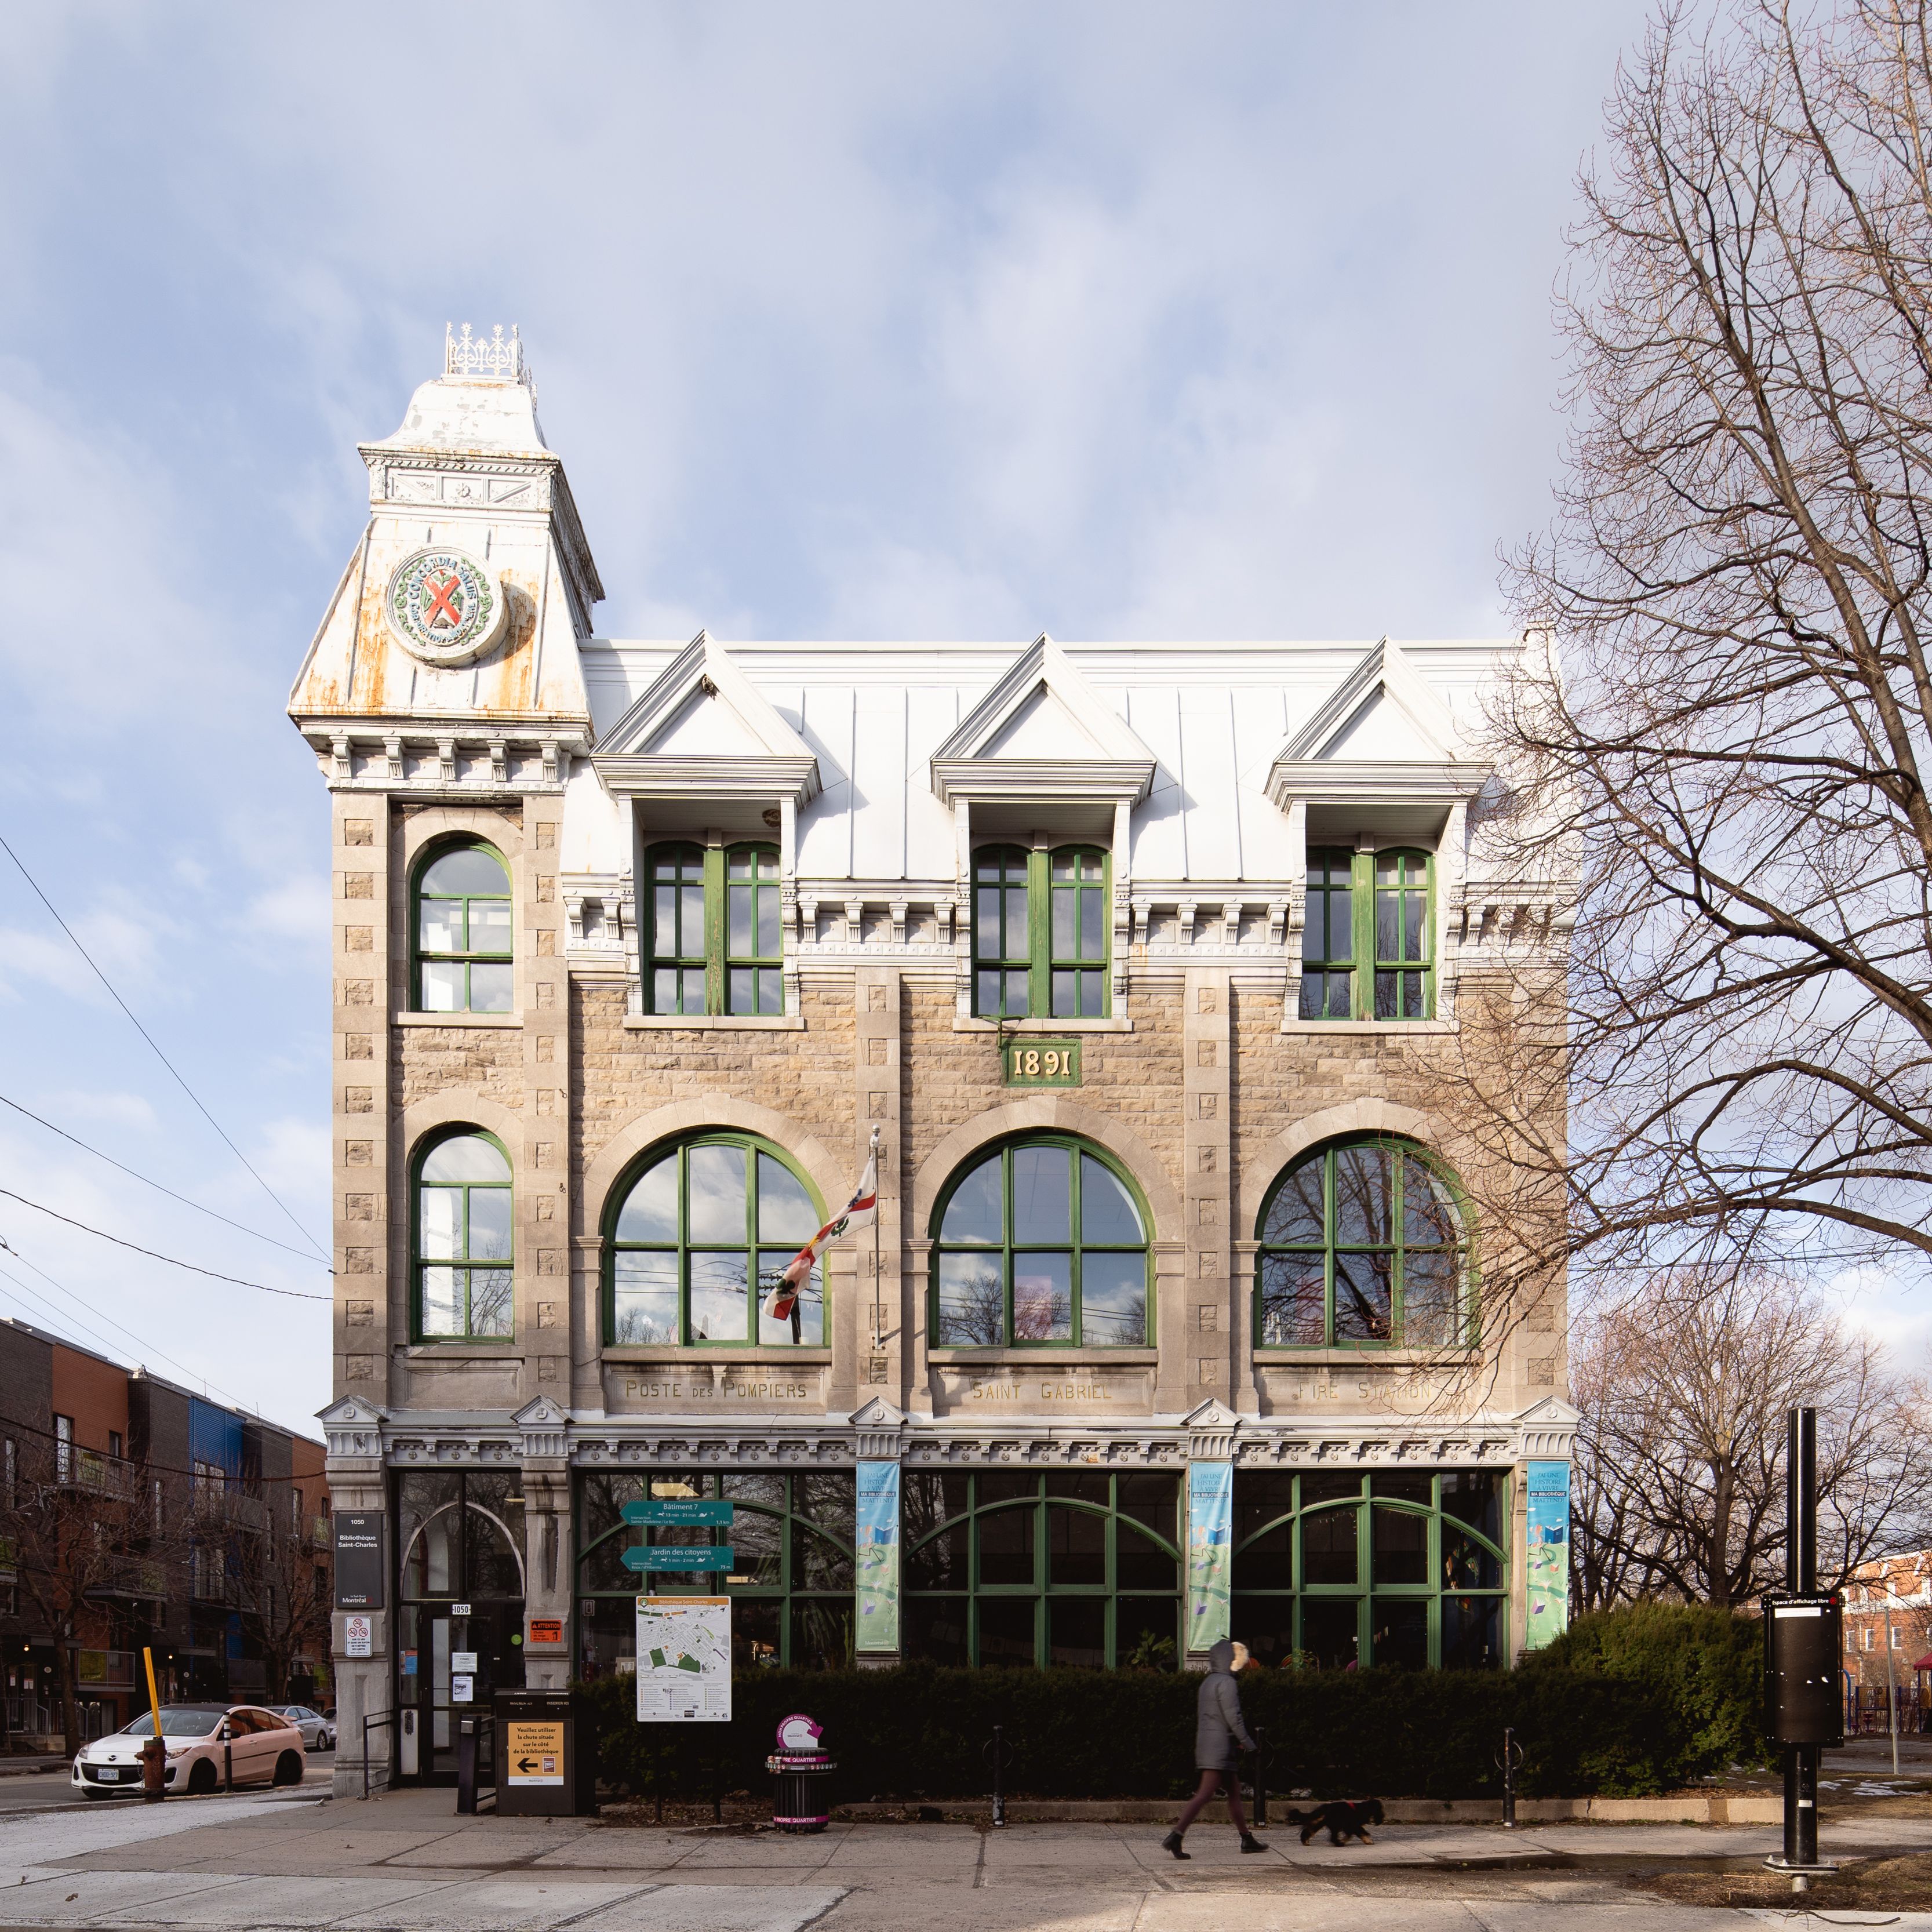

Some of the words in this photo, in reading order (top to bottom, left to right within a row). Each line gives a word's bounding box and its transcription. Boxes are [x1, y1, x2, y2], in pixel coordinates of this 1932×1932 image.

[408, 556, 458, 599] CONCORDIA
[1014, 1050, 1069, 1075] 1891
[625, 1380, 682, 1398] POSTE
[692, 1387, 713, 1398] DES
[723, 1381, 807, 1398] POMPIERS
[973, 1382, 1021, 1399] SAINT
[1041, 1382, 1113, 1399] GABRIEL
[1299, 1382, 1338, 1399] FIRE
[1359, 1382, 1431, 1399] STATION
[781, 1716, 794, 1729] PROPRE
[794, 1715, 813, 1725] QUARTIER
